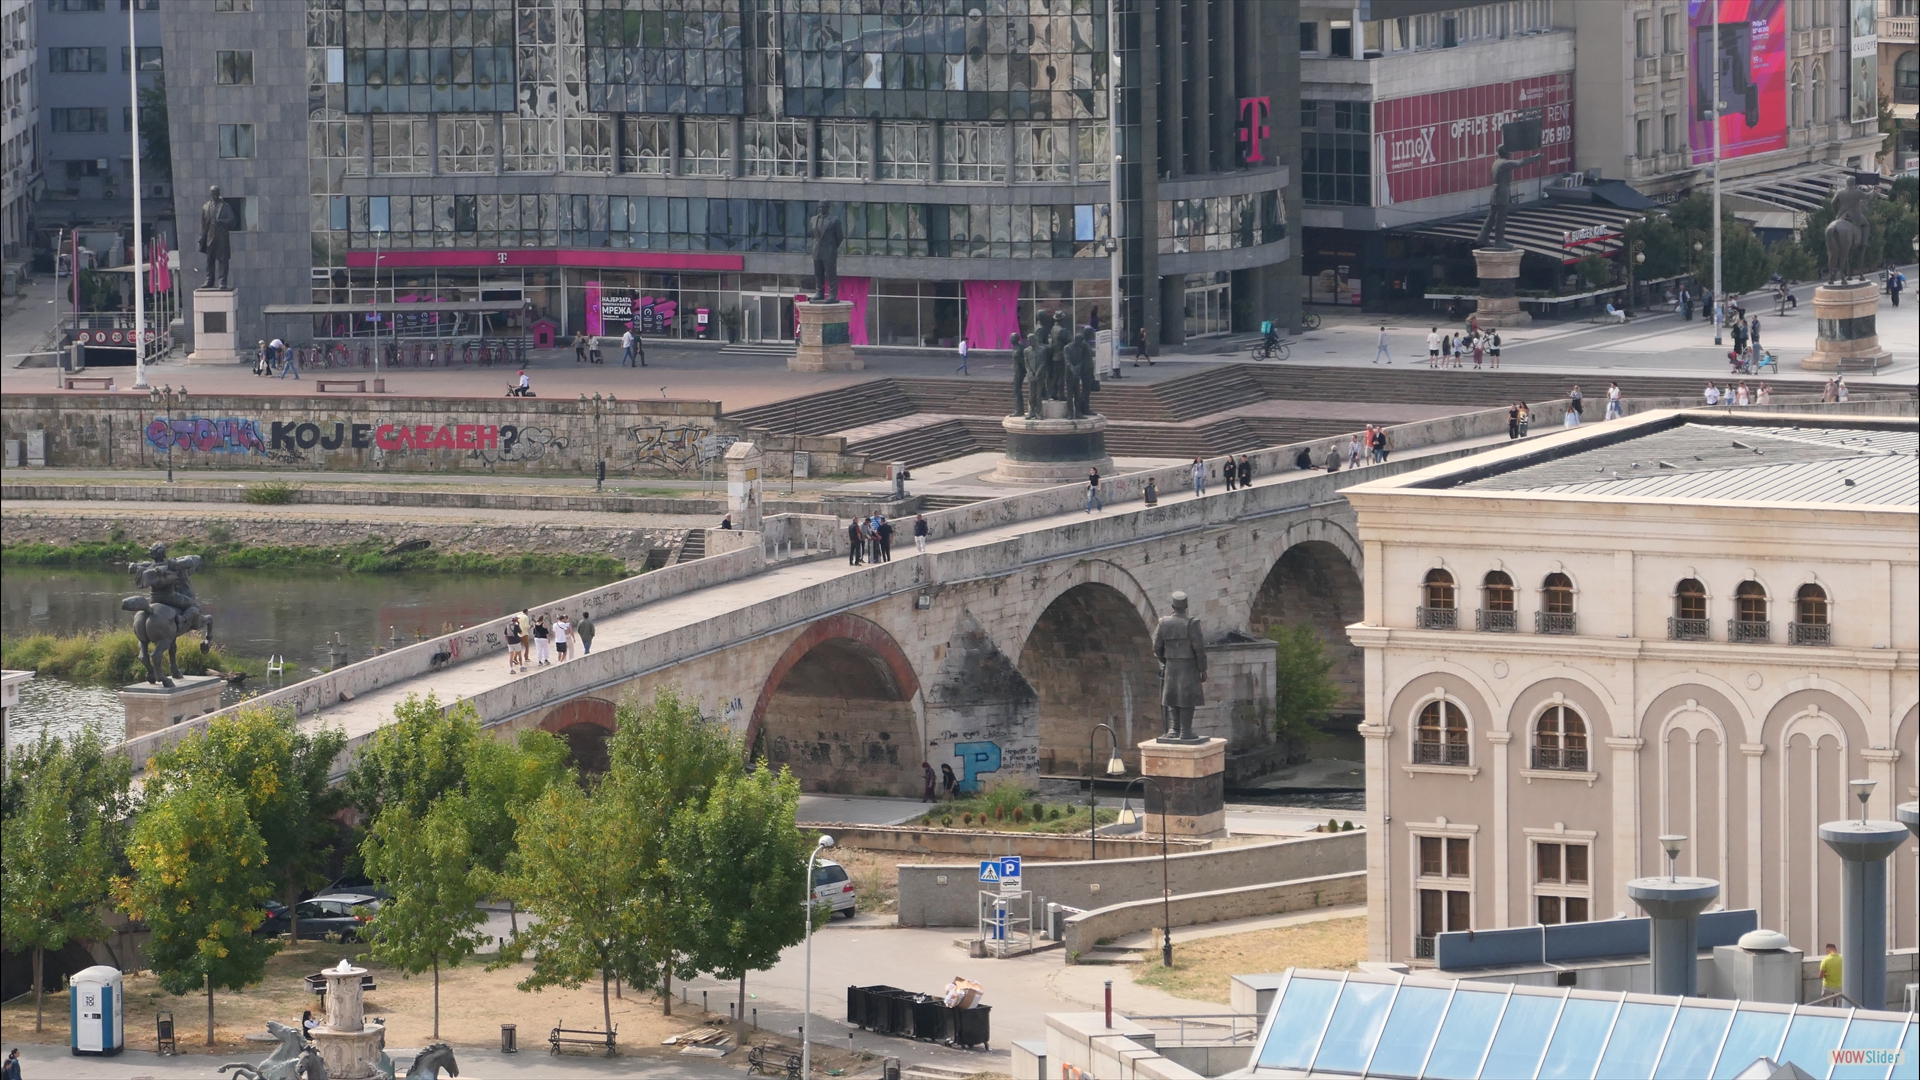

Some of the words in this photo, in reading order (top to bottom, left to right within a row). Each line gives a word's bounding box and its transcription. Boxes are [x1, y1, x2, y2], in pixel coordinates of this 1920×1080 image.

[1853, 40, 1877, 52] CALLIOPE
[1451, 117, 1488, 138] OFFICE
[1549, 103, 1571, 122] RENT
[1240, 96, 1270, 162] T
[1557, 125, 1572, 142] 919
[1571, 228, 1595, 242] BURGER
[498, 252, 508, 264] T
[602, 306, 632, 315] МРЕЖА
[113, 332, 121, 341] 20
[941, 730, 958, 740] The
[963, 730, 980, 739] eyes
[1005, 863, 1015, 875] P
